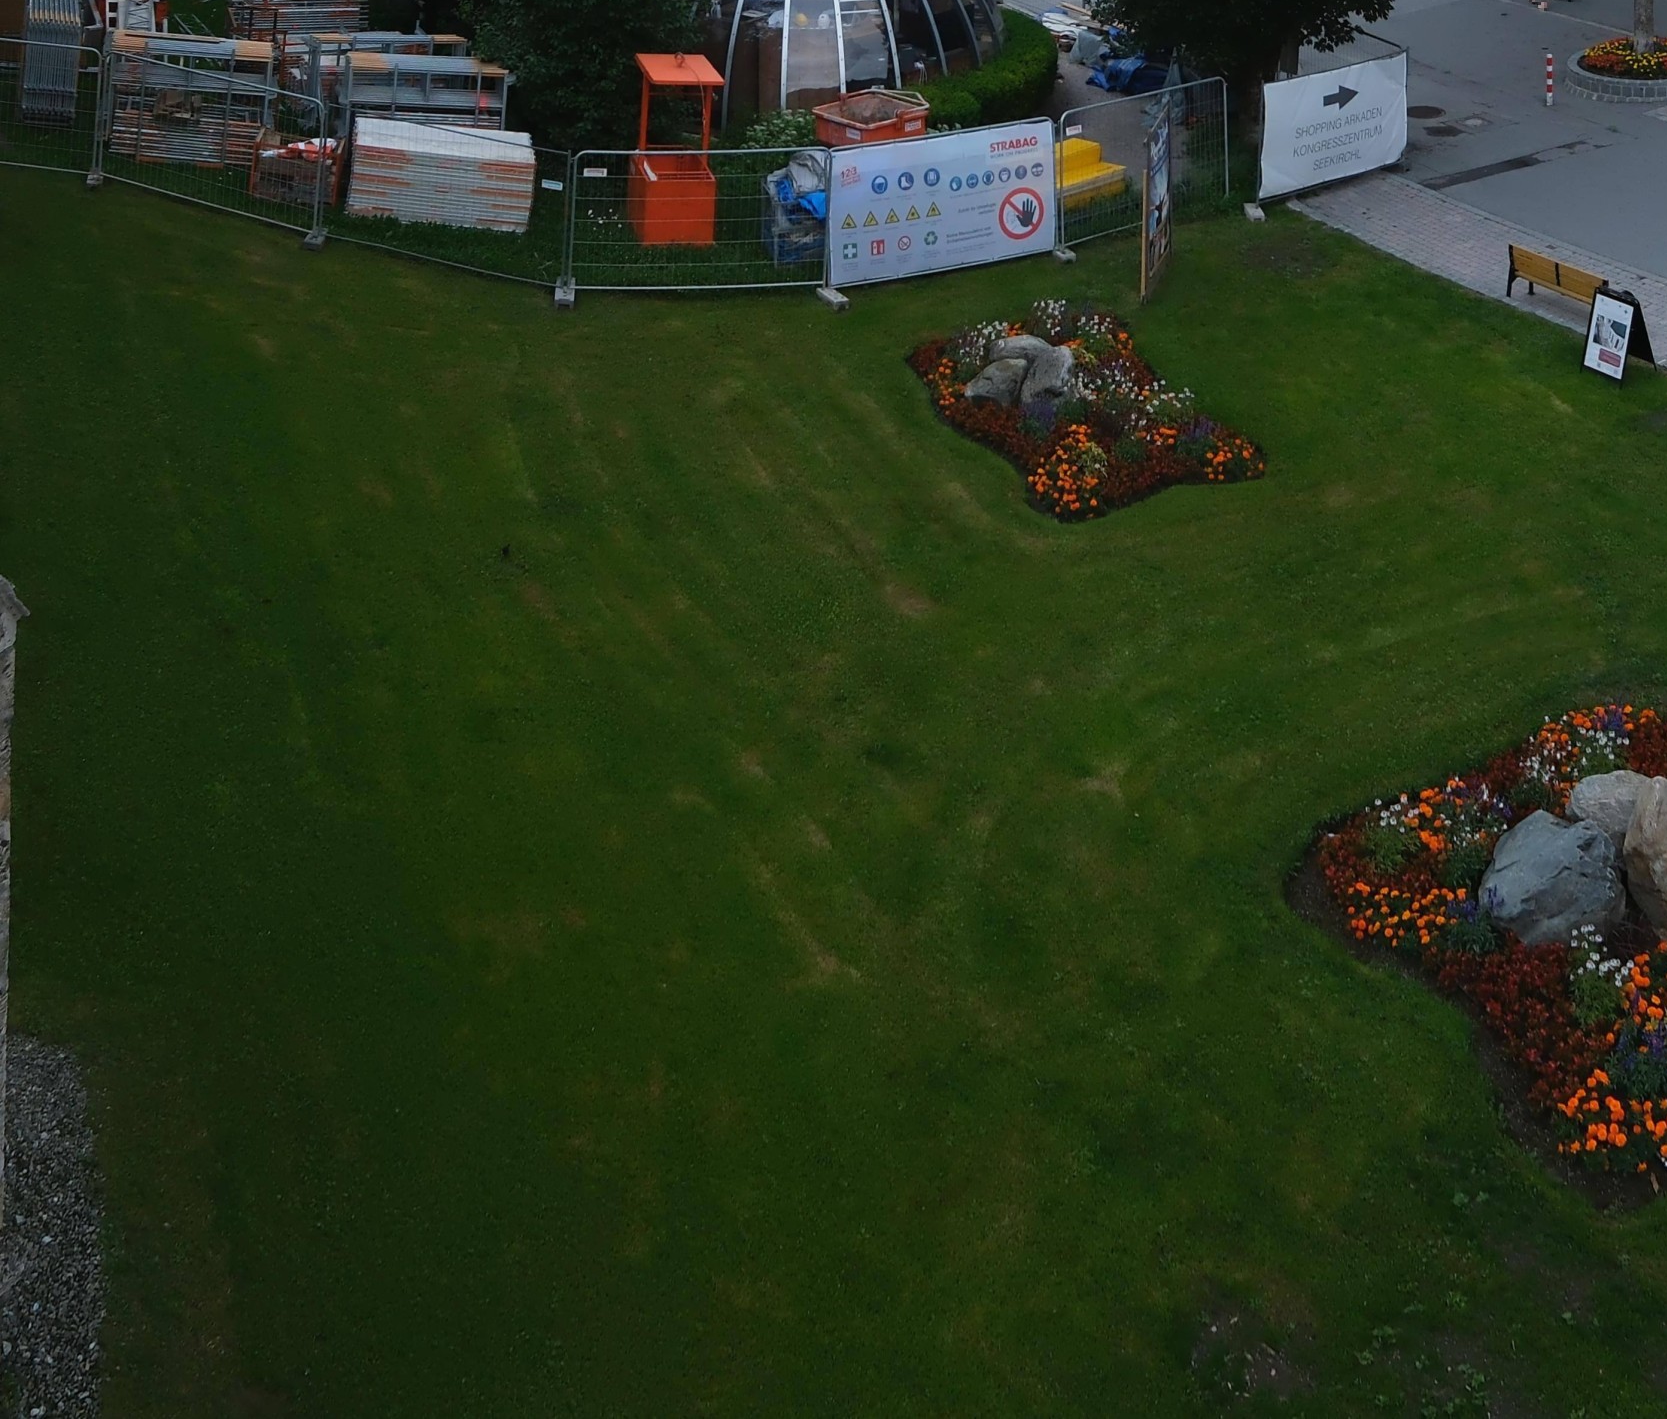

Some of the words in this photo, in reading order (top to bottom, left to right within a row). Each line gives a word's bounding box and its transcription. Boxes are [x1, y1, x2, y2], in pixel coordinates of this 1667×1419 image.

[1294, 118, 1343, 139] SHOPPING
[1343, 106, 1383, 127] ARKADEN
[990, 136, 1038, 153] STRABAG
[1292, 124, 1383, 158] KONGRESSZENTRUM
[1312, 149, 1362, 171] SEEKIRCHL
